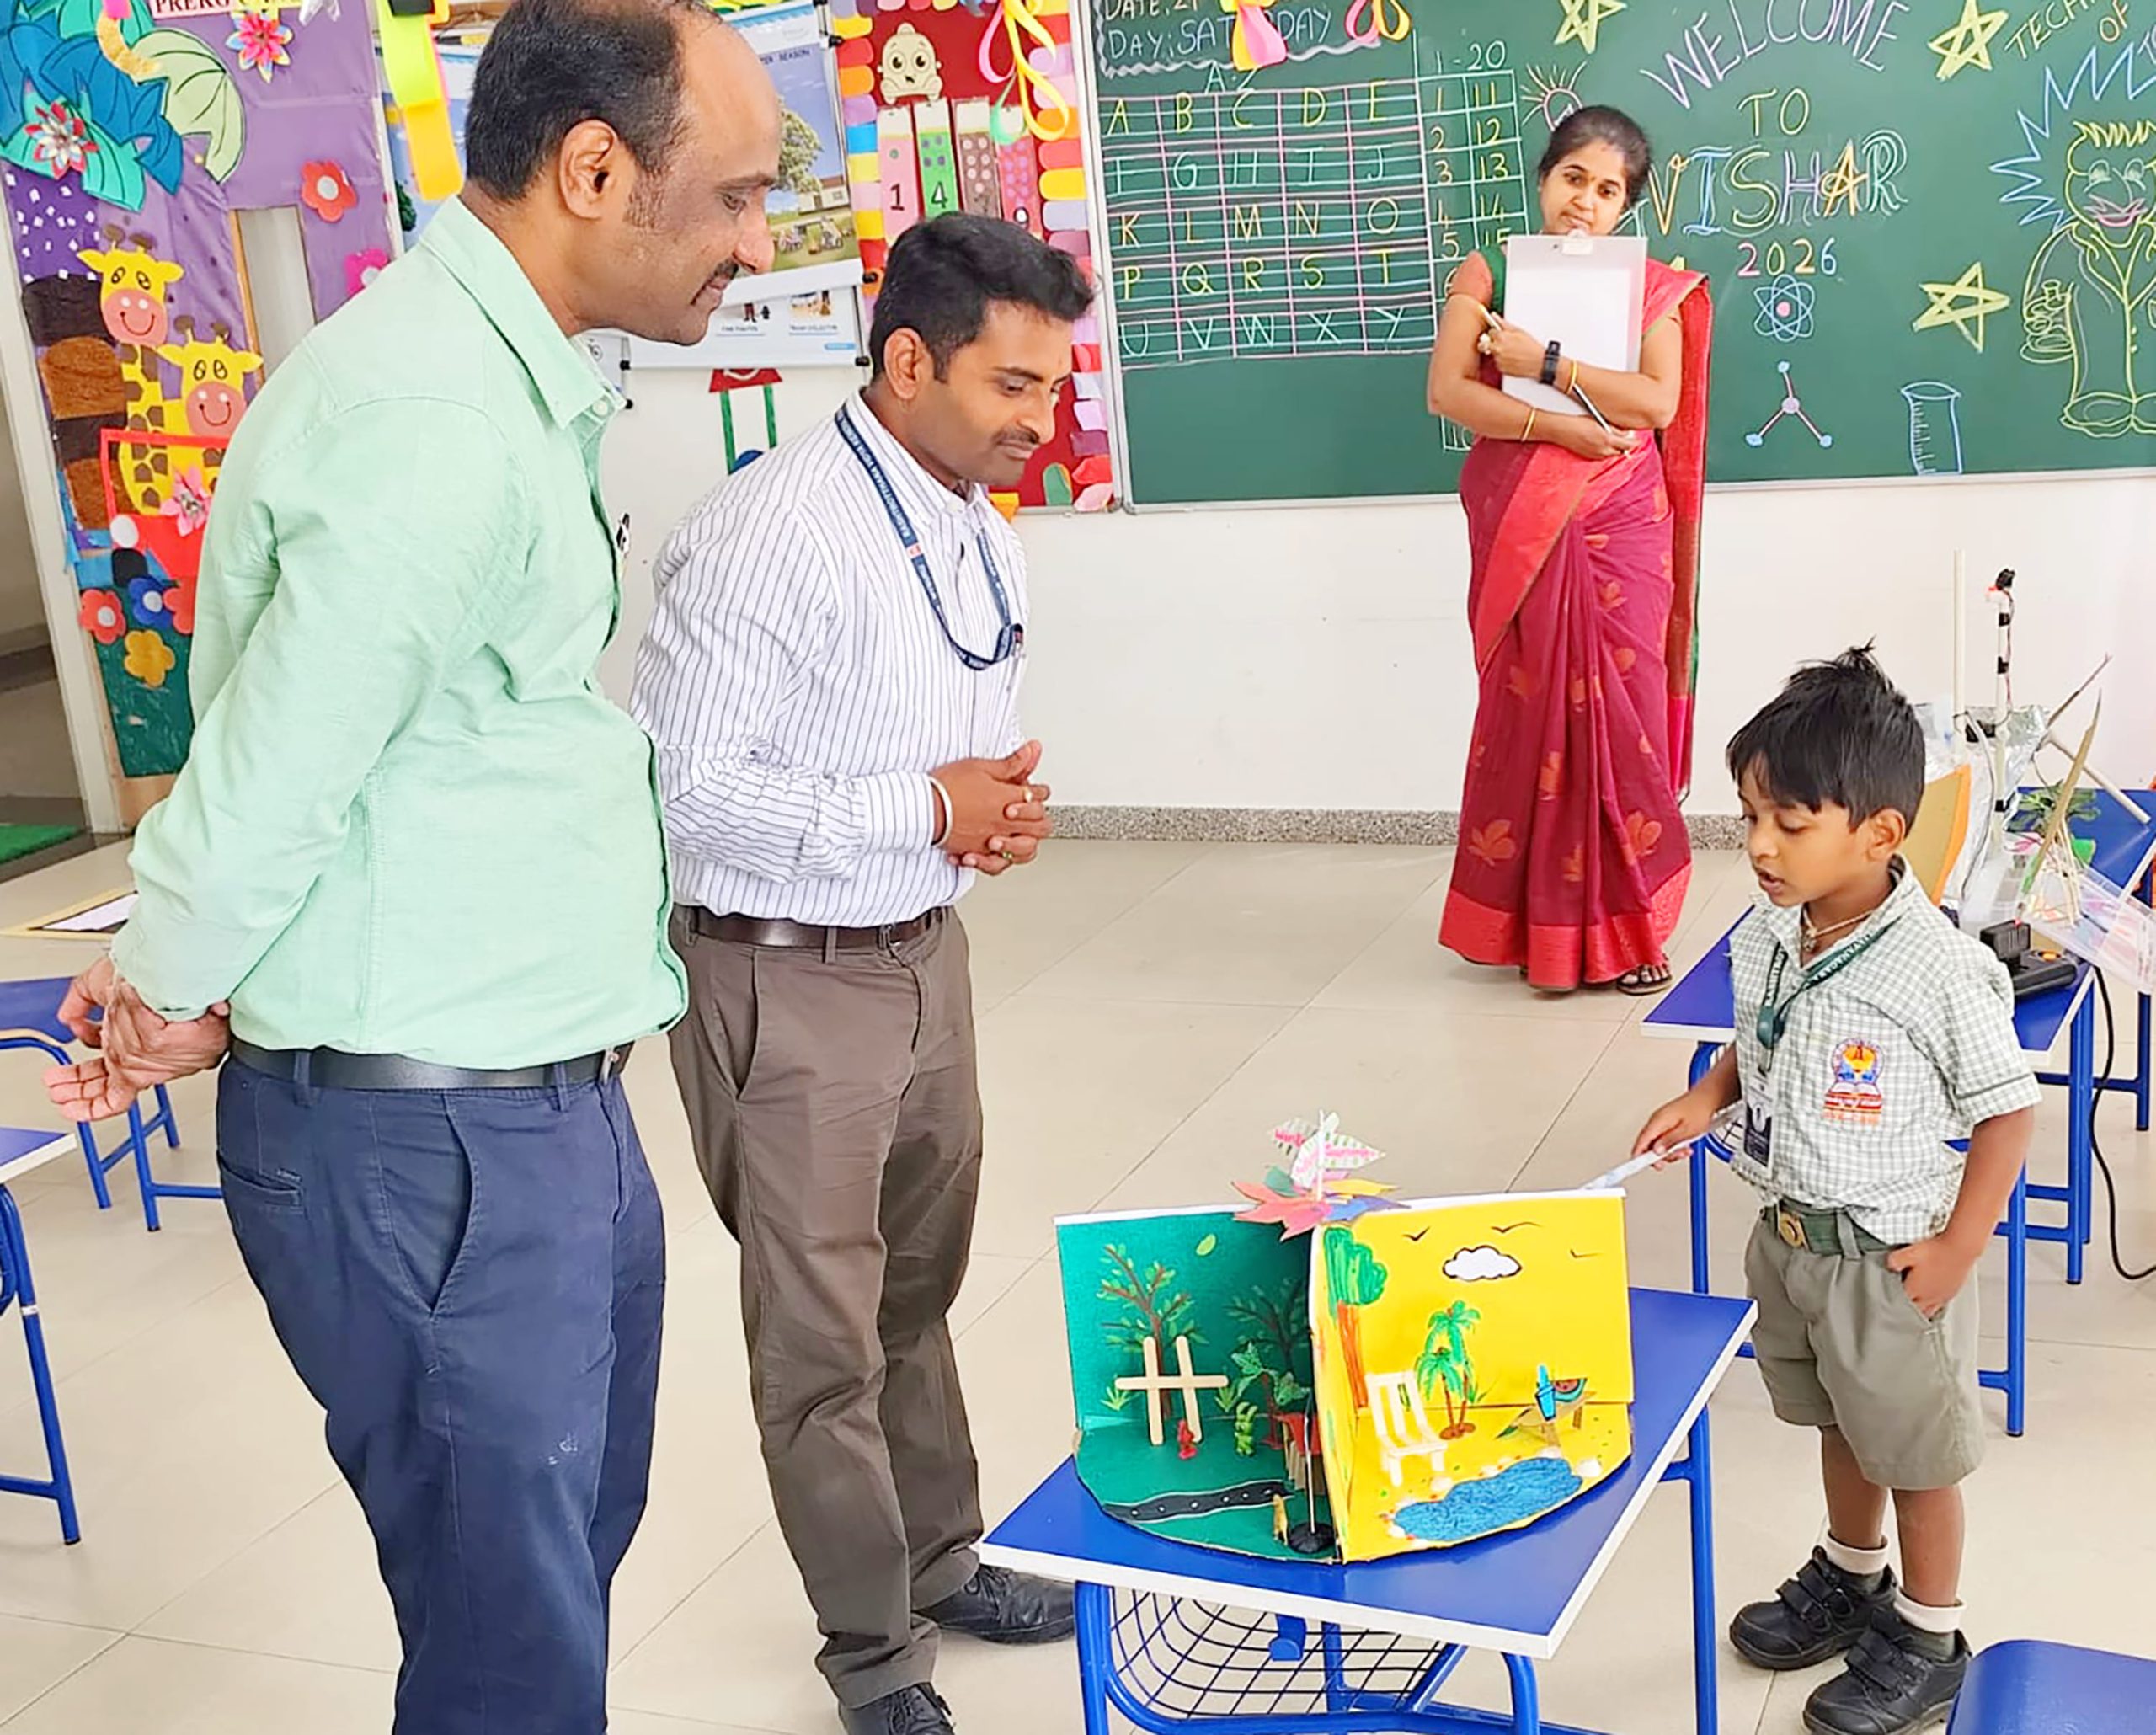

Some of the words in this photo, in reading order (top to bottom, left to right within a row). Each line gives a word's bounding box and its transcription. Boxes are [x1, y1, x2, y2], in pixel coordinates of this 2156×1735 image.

[1640, 0, 1910, 108] WELCOME
[1107, 99, 1129, 135] A
[1177, 93, 1192, 133] B
[1233, 93, 1253, 128] C
[1303, 88, 1326, 125] D
[1369, 82, 1388, 121] E
[1475, 82, 1496, 108] 11
[1737, 88, 1809, 136] TO
[1430, 126, 1444, 152] 2
[1476, 118, 1501, 145] 12
[1173, 152, 1198, 188] G
[1232, 151, 1258, 185] H
[1435, 160, 1453, 185] 3
[1481, 153, 1508, 181] 13
[890, 183, 905, 211] 1
[931, 181, 948, 209] 4
[1121, 213, 1140, 248] K
[1186, 211, 1205, 243] L
[1235, 205, 1262, 240] M
[1295, 201, 1320, 237] N
[1368, 198, 1399, 235] O
[1441, 232, 1460, 260] 5
[1737, 238, 1837, 277] 2026
[1124, 266, 1141, 300] P
[1182, 263, 1214, 294] Q
[1244, 258, 1262, 291] R
[1301, 254, 1324, 288] S
[1121, 321, 1148, 356] U
[1188, 318, 1213, 350] V
[1242, 314, 1274, 346] W
[1310, 312, 1340, 344] X
[1375, 307, 1404, 340] Y
